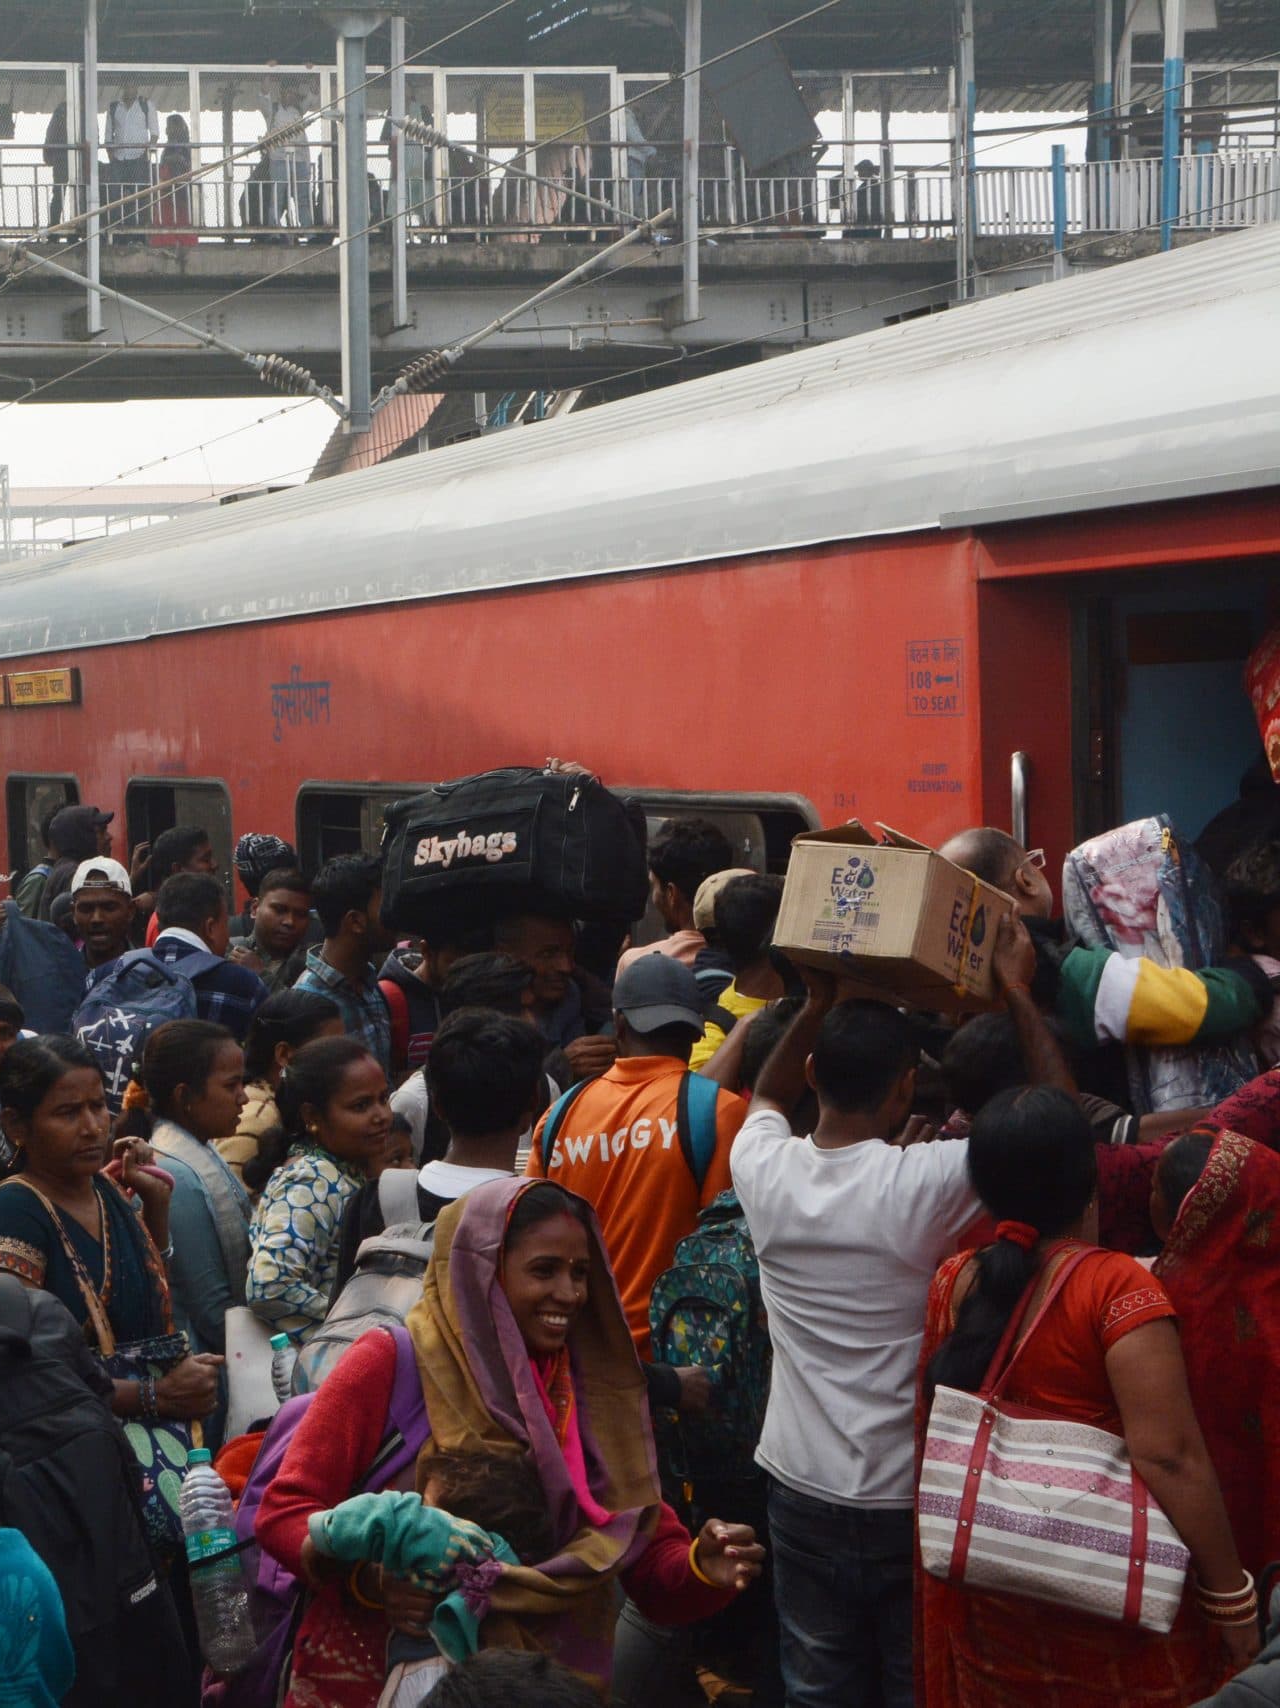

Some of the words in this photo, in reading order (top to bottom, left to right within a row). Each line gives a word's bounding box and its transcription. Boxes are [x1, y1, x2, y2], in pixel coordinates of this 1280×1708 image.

[910, 671, 932, 689] 108
[913, 695, 928, 711] TO
[931, 695, 958, 711] SEAT
[907, 779, 963, 792] RESERVATION
[830, 886, 875, 900] Water
[550, 1119, 678, 1167] SWIGGY
